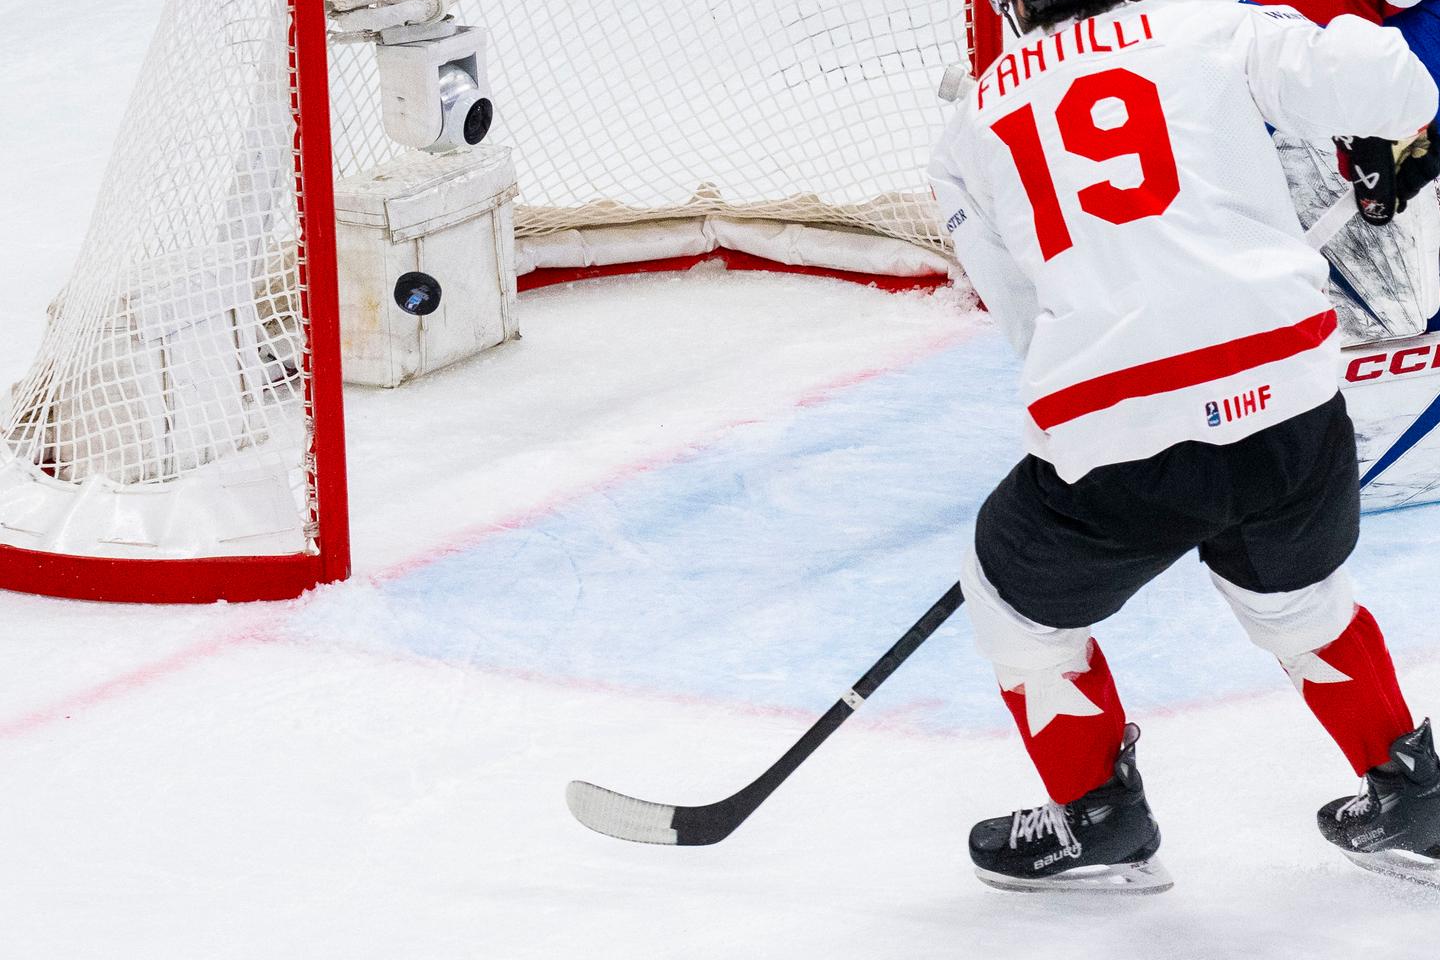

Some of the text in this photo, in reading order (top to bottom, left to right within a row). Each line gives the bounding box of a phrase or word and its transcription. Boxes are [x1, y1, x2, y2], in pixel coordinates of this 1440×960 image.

[977, 13, 1153, 111] FANTILLI
[990, 67, 1182, 263] 19
[1223, 384, 1271, 422] IIHF
